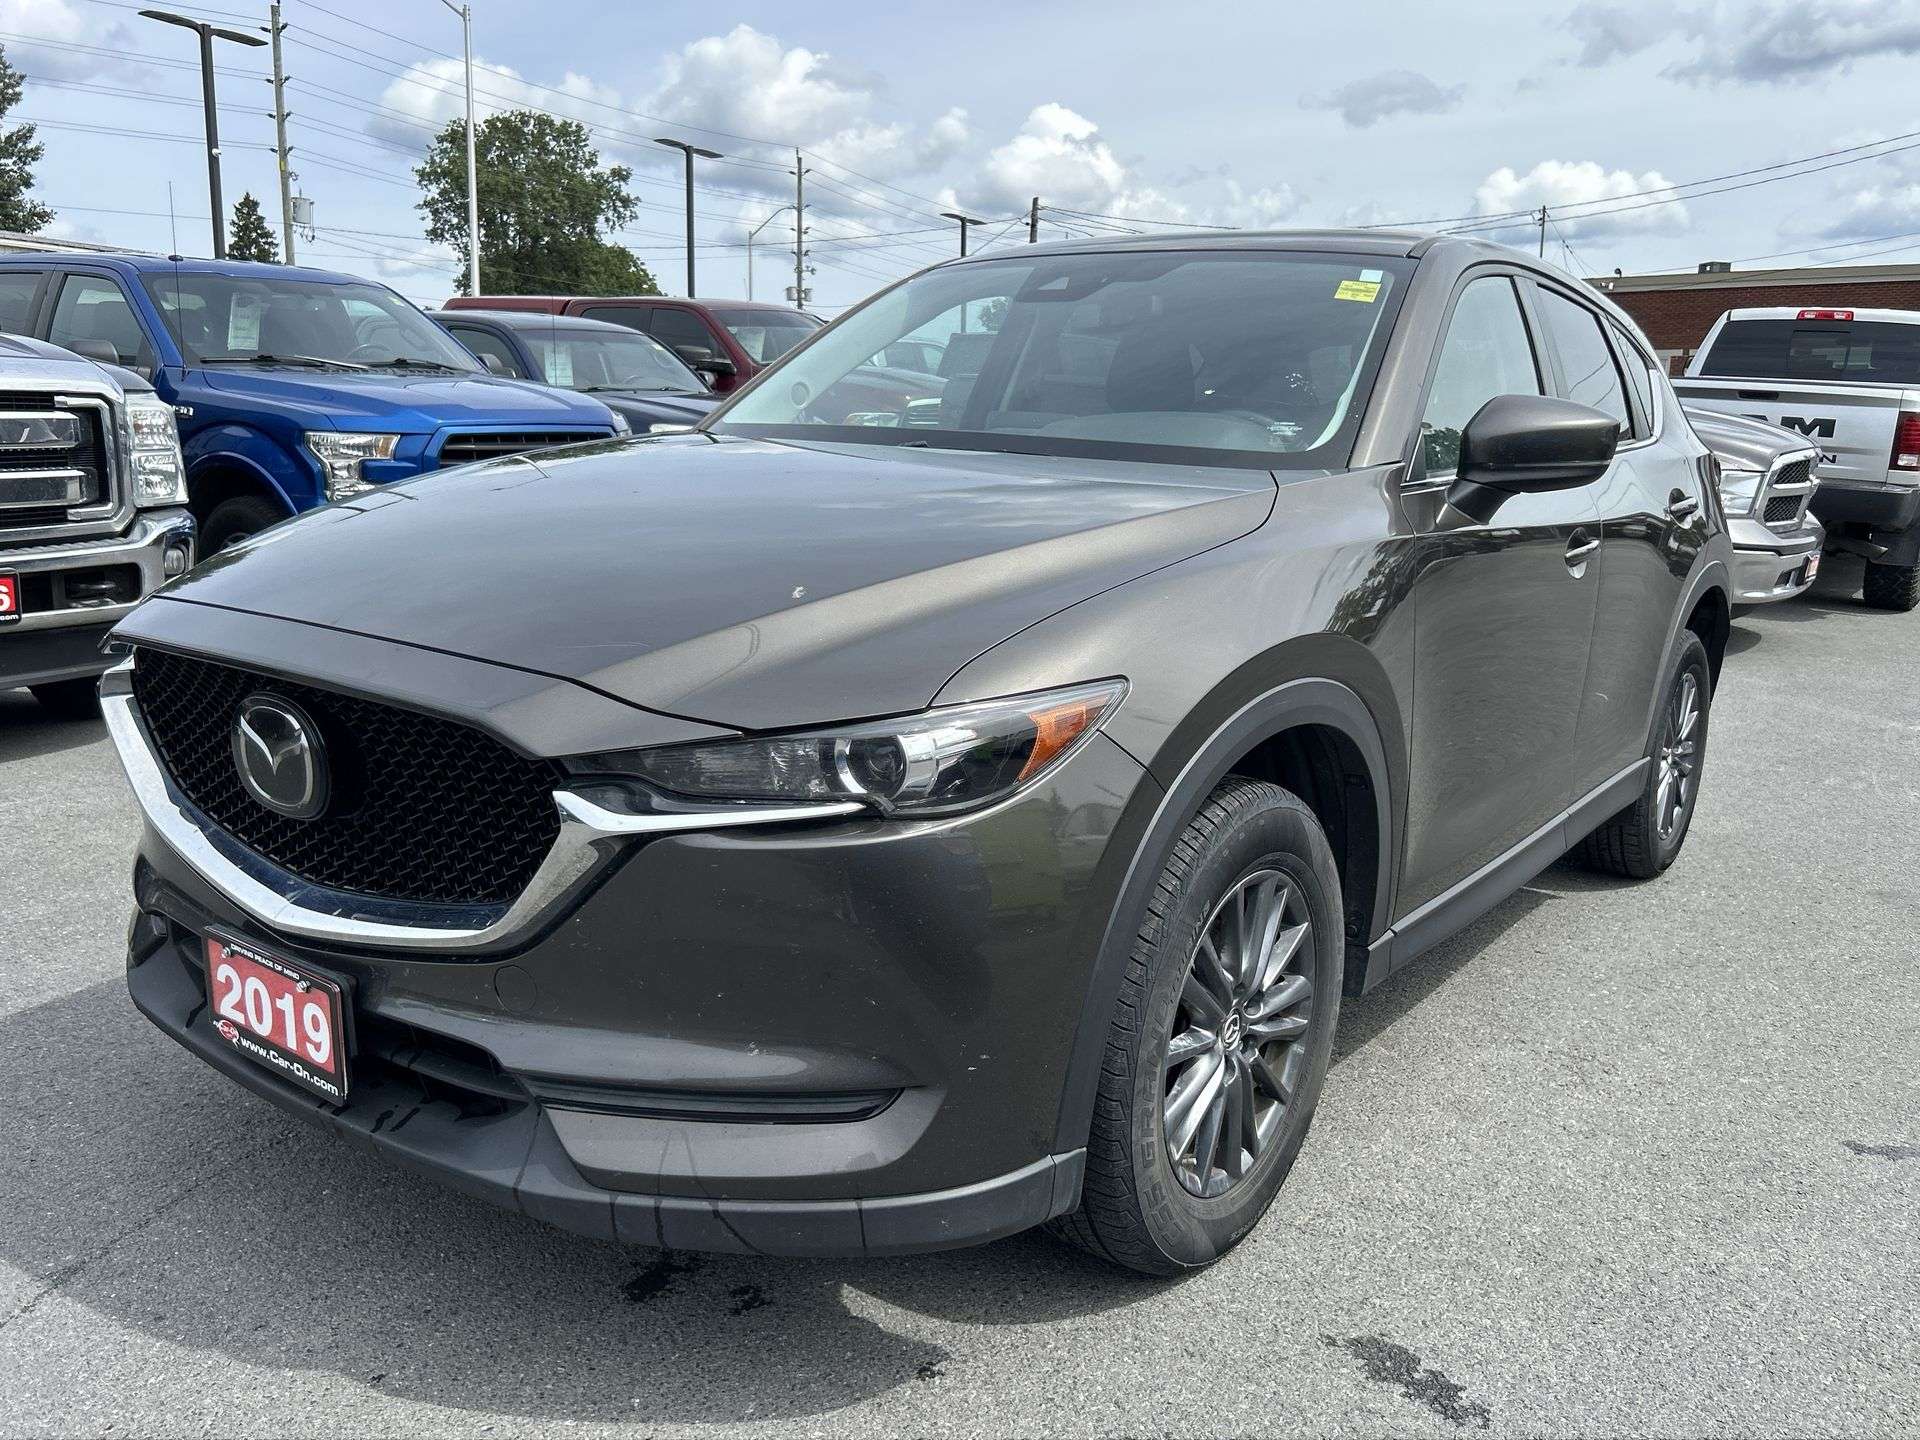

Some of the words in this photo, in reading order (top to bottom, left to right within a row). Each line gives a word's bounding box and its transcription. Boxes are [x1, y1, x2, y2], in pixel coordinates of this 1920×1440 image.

[254, 953, 274, 968] PEACE
[274, 963, 283, 971] OF
[283, 967, 300, 980] MIND
[216, 963, 330, 1064] 2019
[240, 1036, 339, 1096] www.Car-On.com
